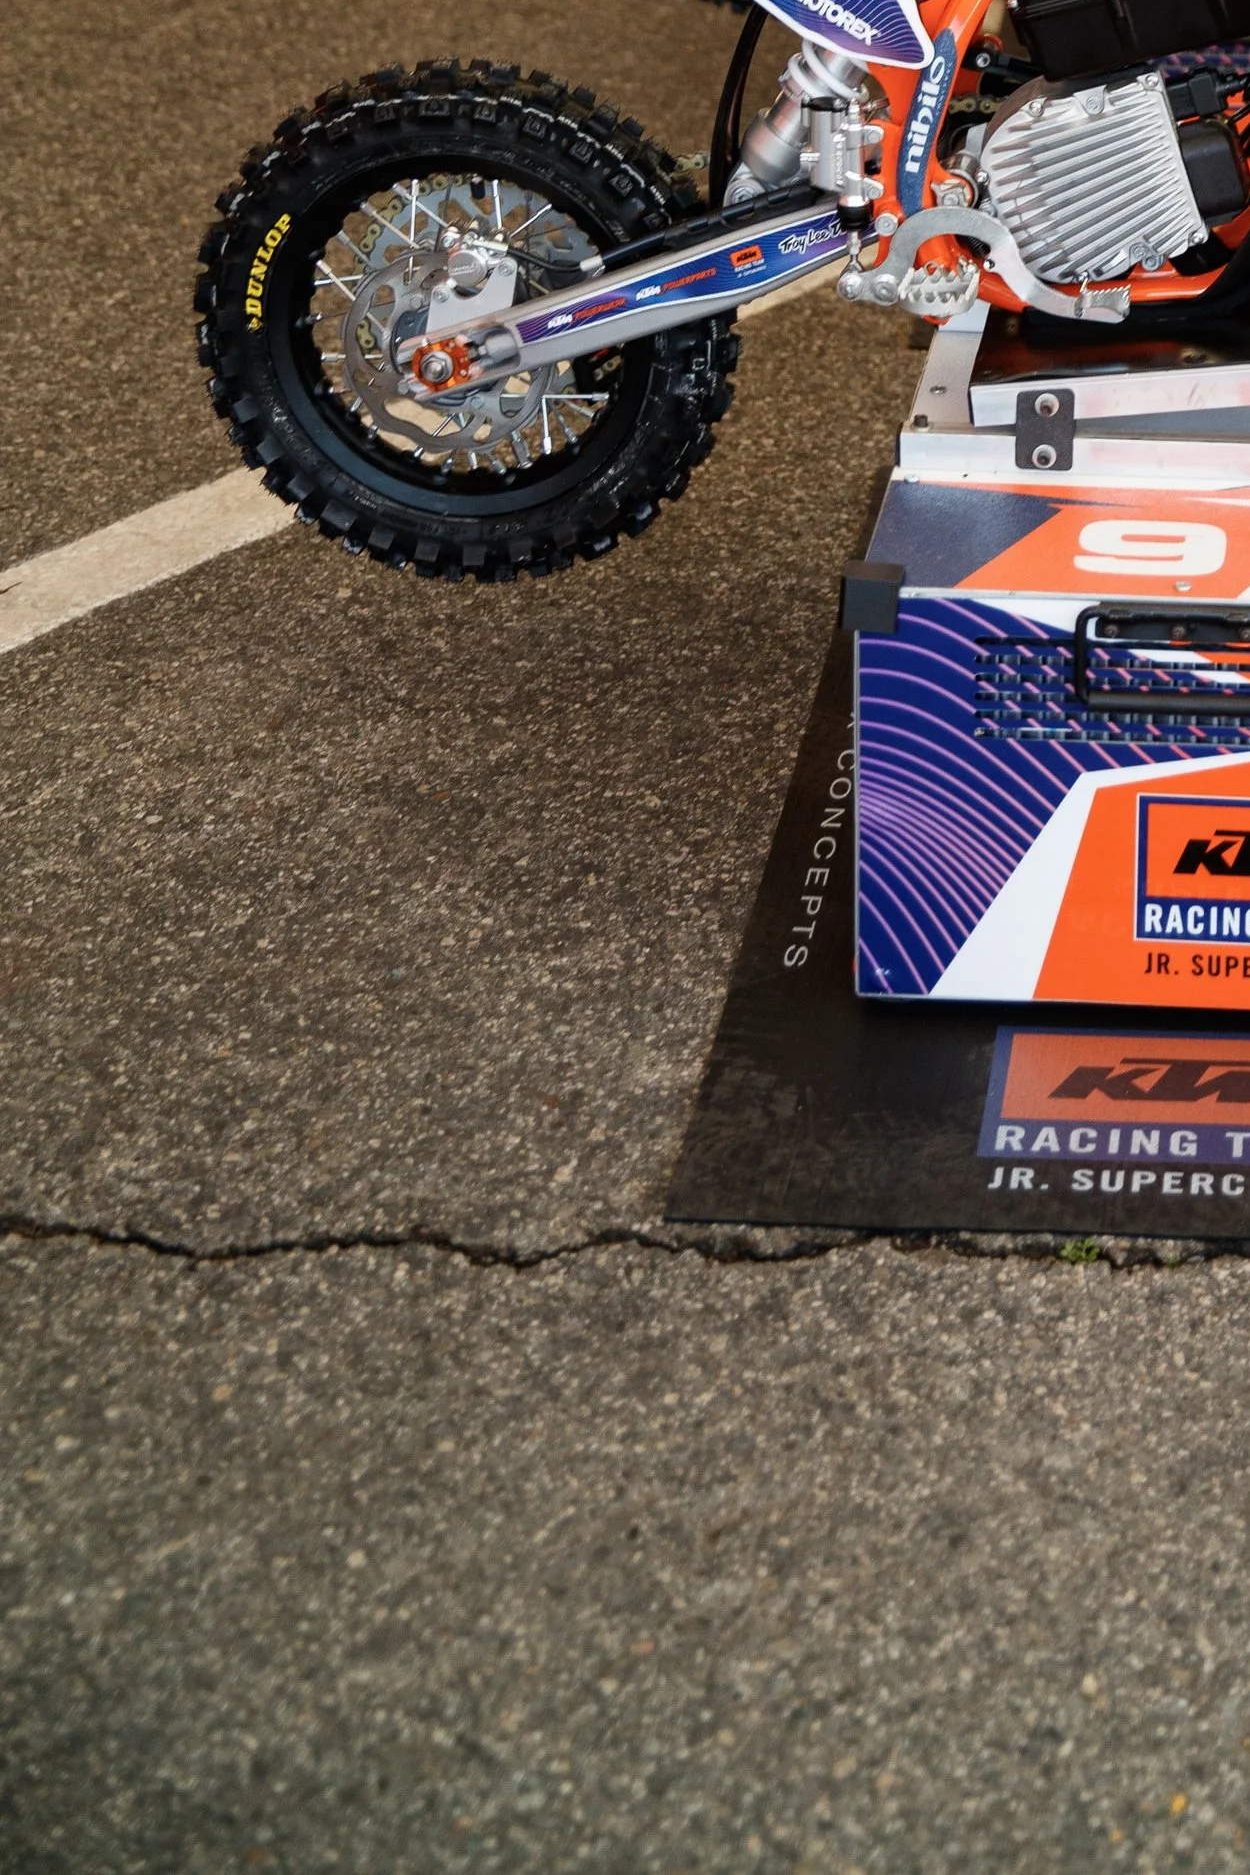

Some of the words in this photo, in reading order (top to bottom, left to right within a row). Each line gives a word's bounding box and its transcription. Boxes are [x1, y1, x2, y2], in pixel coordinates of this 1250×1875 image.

[778, 236, 807, 254] Troy
[806, 228, 830, 246] Lee
[245, 213, 291, 318] DUNLOP
[635, 285, 661, 302] KTM
[547, 312, 573, 329] KTM
[1073, 520, 1227, 576] 9
[783, 748, 856, 968] CONCEPTS
[1144, 952, 1179, 976] JR.
[994, 1125, 1199, 1158] RACING
[987, 1166, 1050, 1191] JR.
